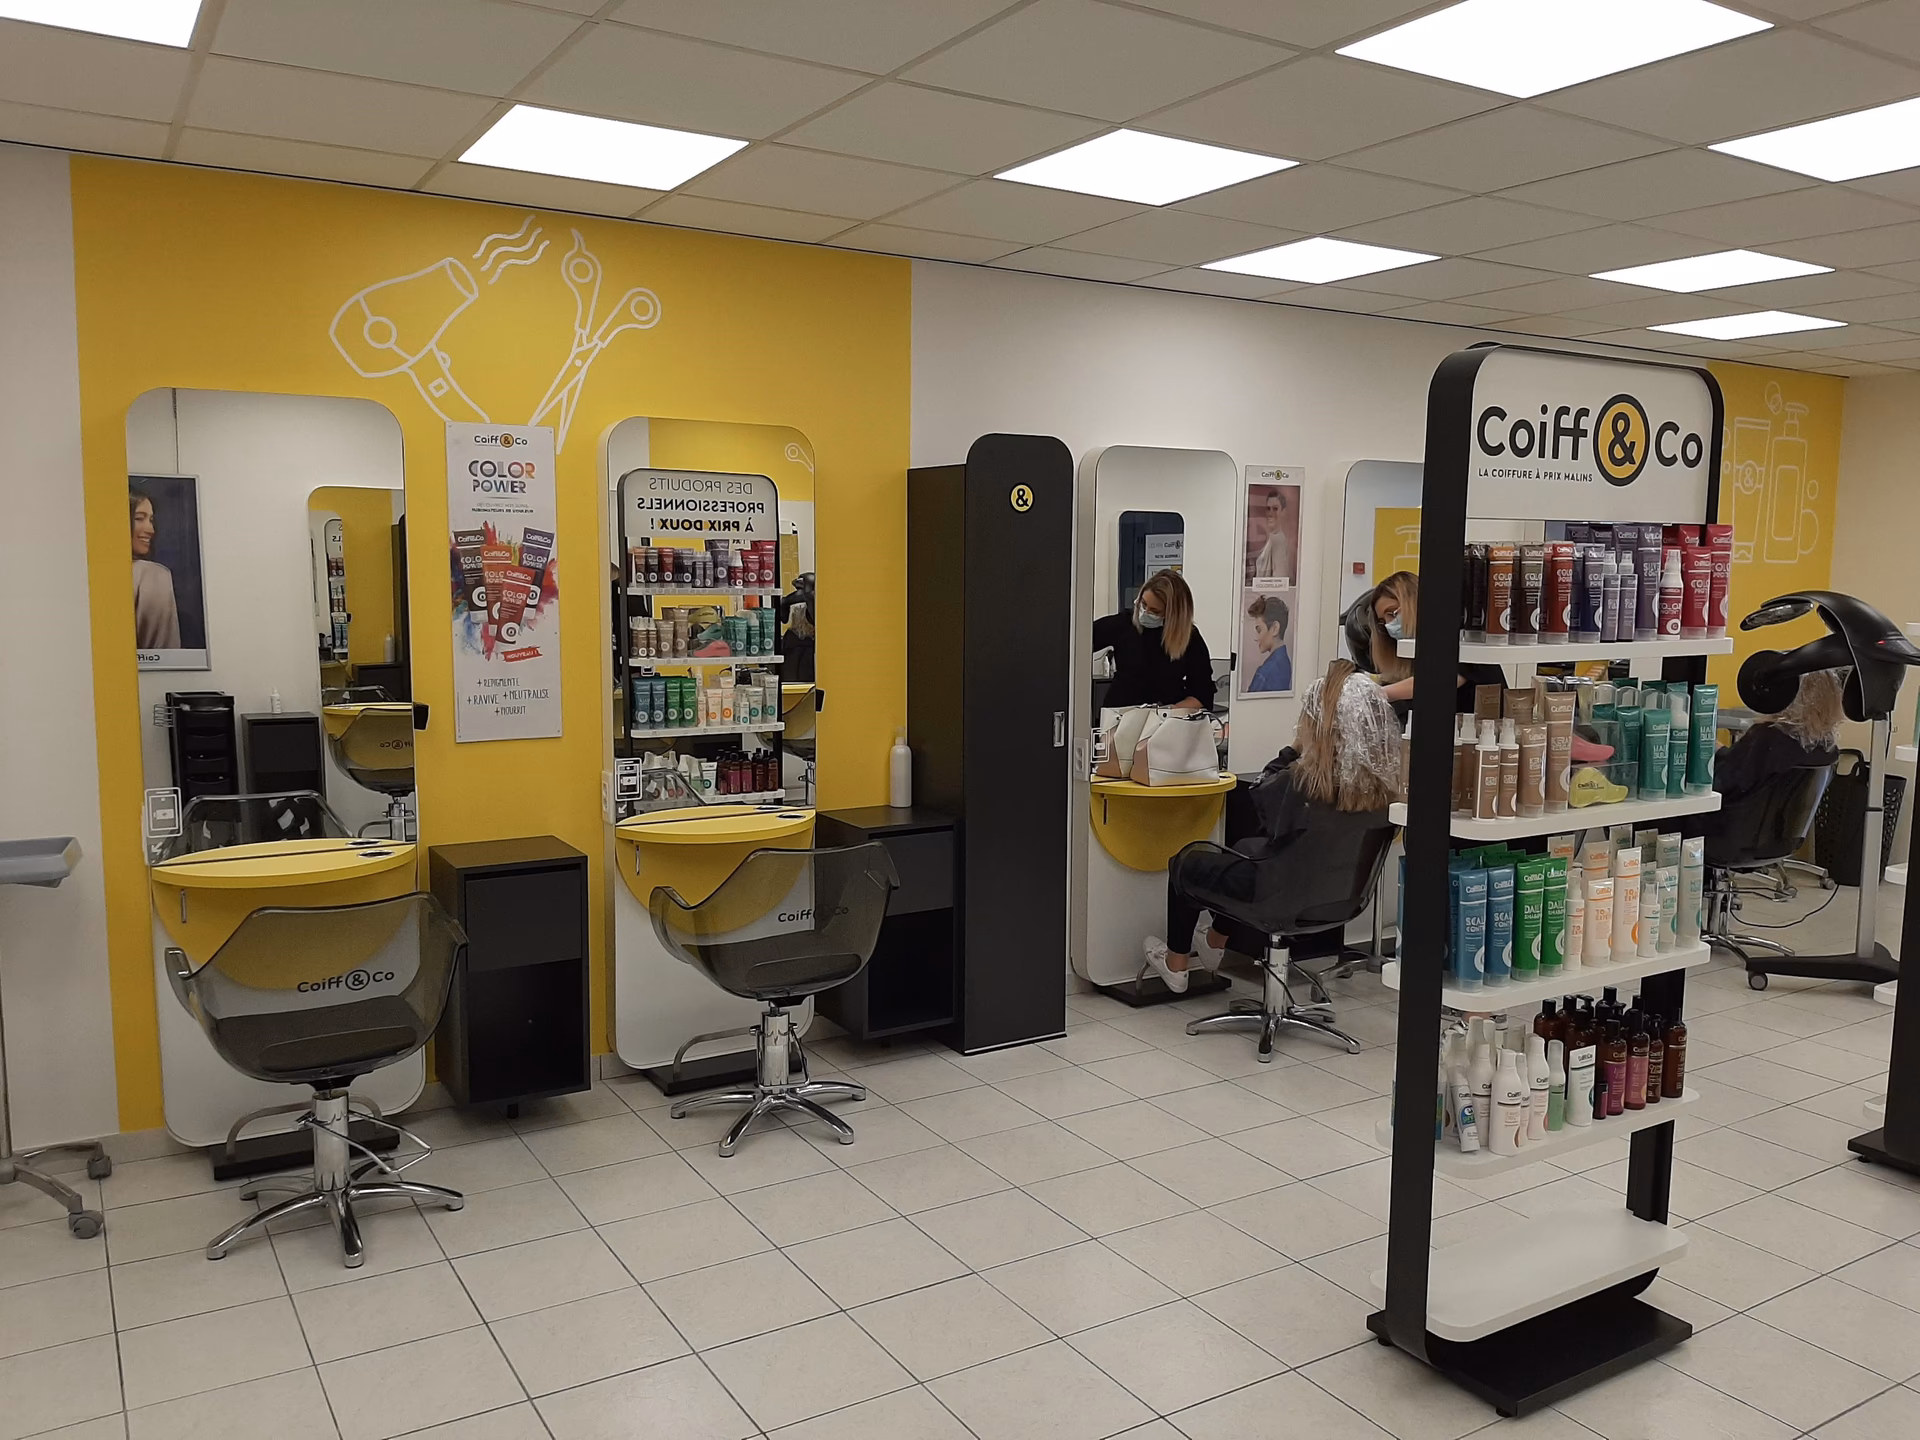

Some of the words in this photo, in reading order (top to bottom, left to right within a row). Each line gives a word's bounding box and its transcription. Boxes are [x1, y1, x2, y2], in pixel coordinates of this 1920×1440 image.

[468, 460, 536, 479] COLOR
[1478, 467, 1489, 477] LA
[1491, 468, 1533, 479] COIFFURE
[1535, 467, 1541, 480] À
[1543, 471, 1562, 481] PRIX
[1564, 471, 1593, 482] MALINS
[472, 479, 527, 494] POWER
[777, 908, 812, 923] Coiff
[297, 975, 344, 993] Coiff
[372, 970, 395, 983] Co
